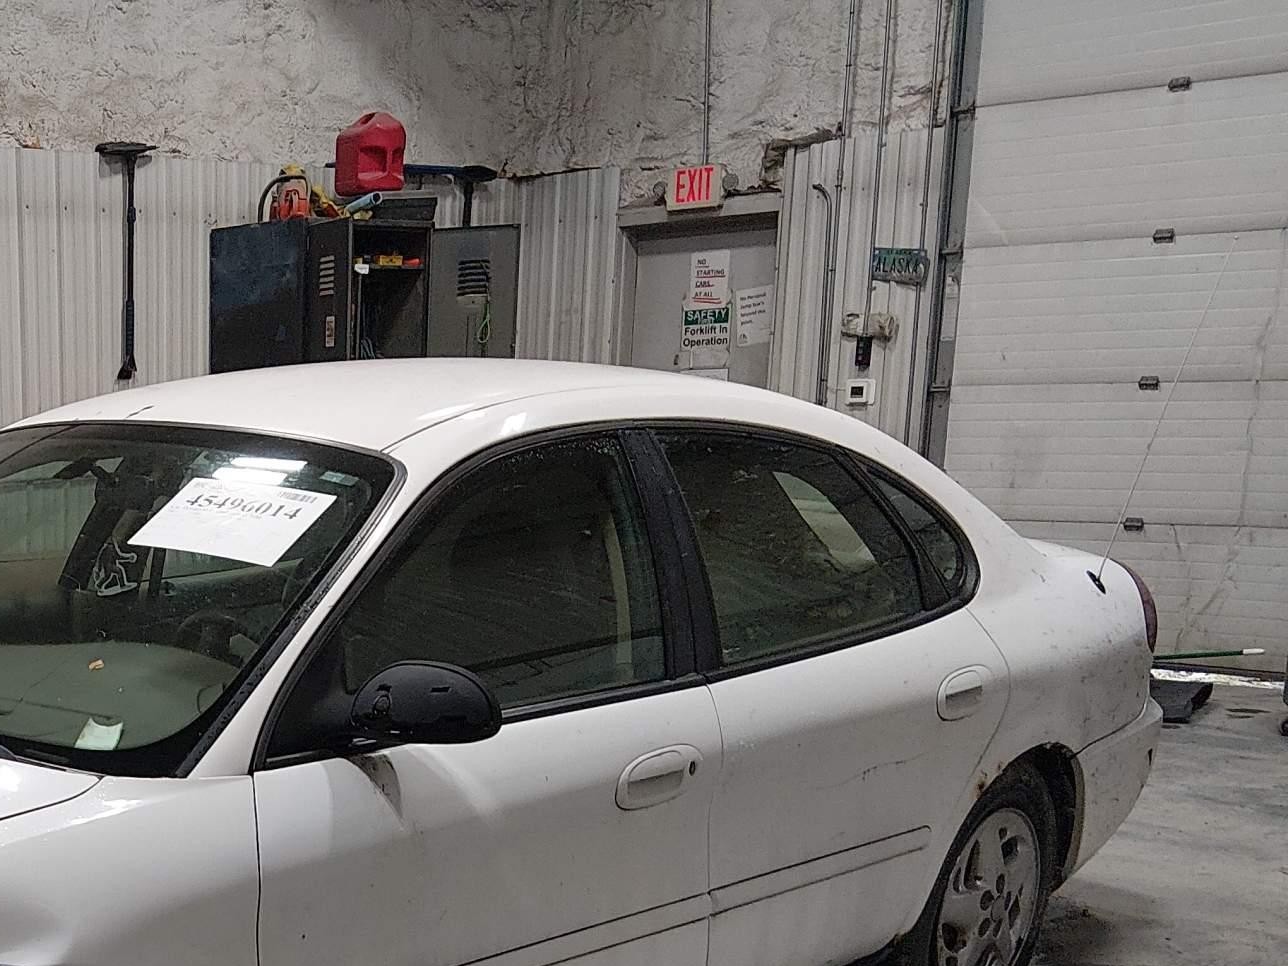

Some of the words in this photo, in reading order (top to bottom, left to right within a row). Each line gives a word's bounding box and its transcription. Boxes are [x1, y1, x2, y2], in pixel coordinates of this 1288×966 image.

[675, 167, 714, 203] EXIT
[874, 256, 920, 274] ALASKA
[696, 268, 725, 276] STARTING
[686, 308, 727, 321] SAFETY
[684, 325, 717, 336] Forklift
[719, 324, 728, 334] In
[683, 336, 728, 348] Operation
[185, 494, 303, 520] 45496014
